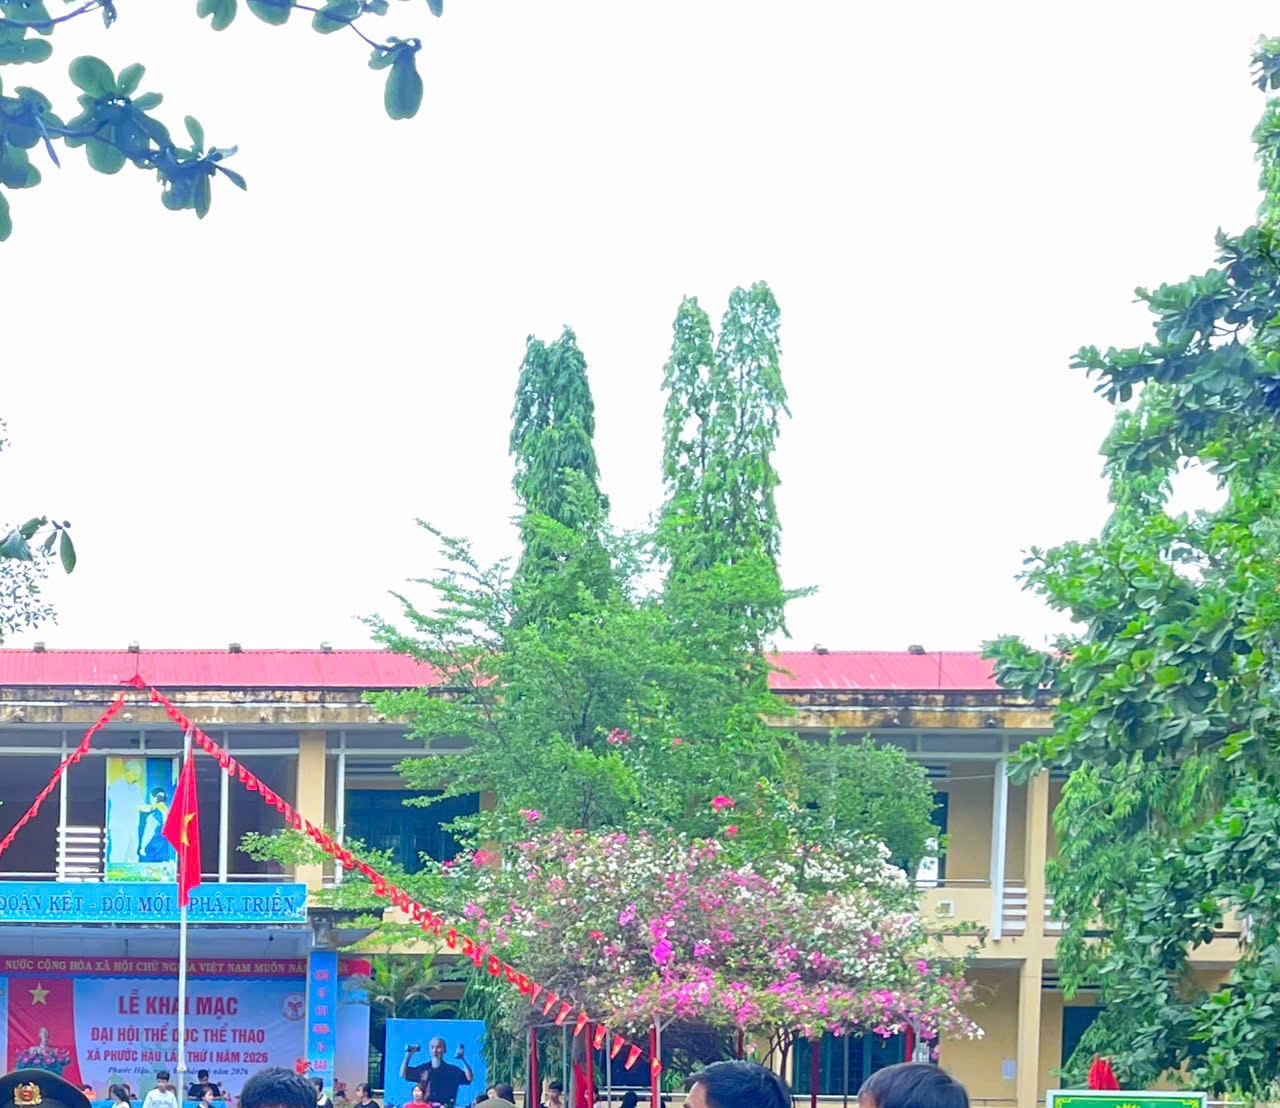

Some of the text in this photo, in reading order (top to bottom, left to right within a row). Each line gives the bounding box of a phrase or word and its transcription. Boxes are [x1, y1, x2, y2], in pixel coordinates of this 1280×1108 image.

[48, 889, 83, 911] KẾT
[138, 892, 170, 912] MỚI
[242, 887, 295, 913] TRIỂN
[5, 959, 34, 970] NƯỚC
[114, 960, 133, 972] HỘI
[199, 961, 224, 974] VIỆT
[228, 963, 251, 974] NAM
[289, 961, 307, 974] NĂ
[196, 996, 239, 1020] MẠC
[91, 1026, 114, 1044] ĐẠI
[118, 1024, 140, 1045] HỘI
[231, 1029, 265, 1044] THAO
[87, 1048, 101, 1061] XÃ
[103, 1048, 138, 1062] PHƯỚC
[141, 1049, 162, 1064] HẬU
[216, 1050, 240, 1063] NĂM
[243, 1052, 268, 1063] 2026
